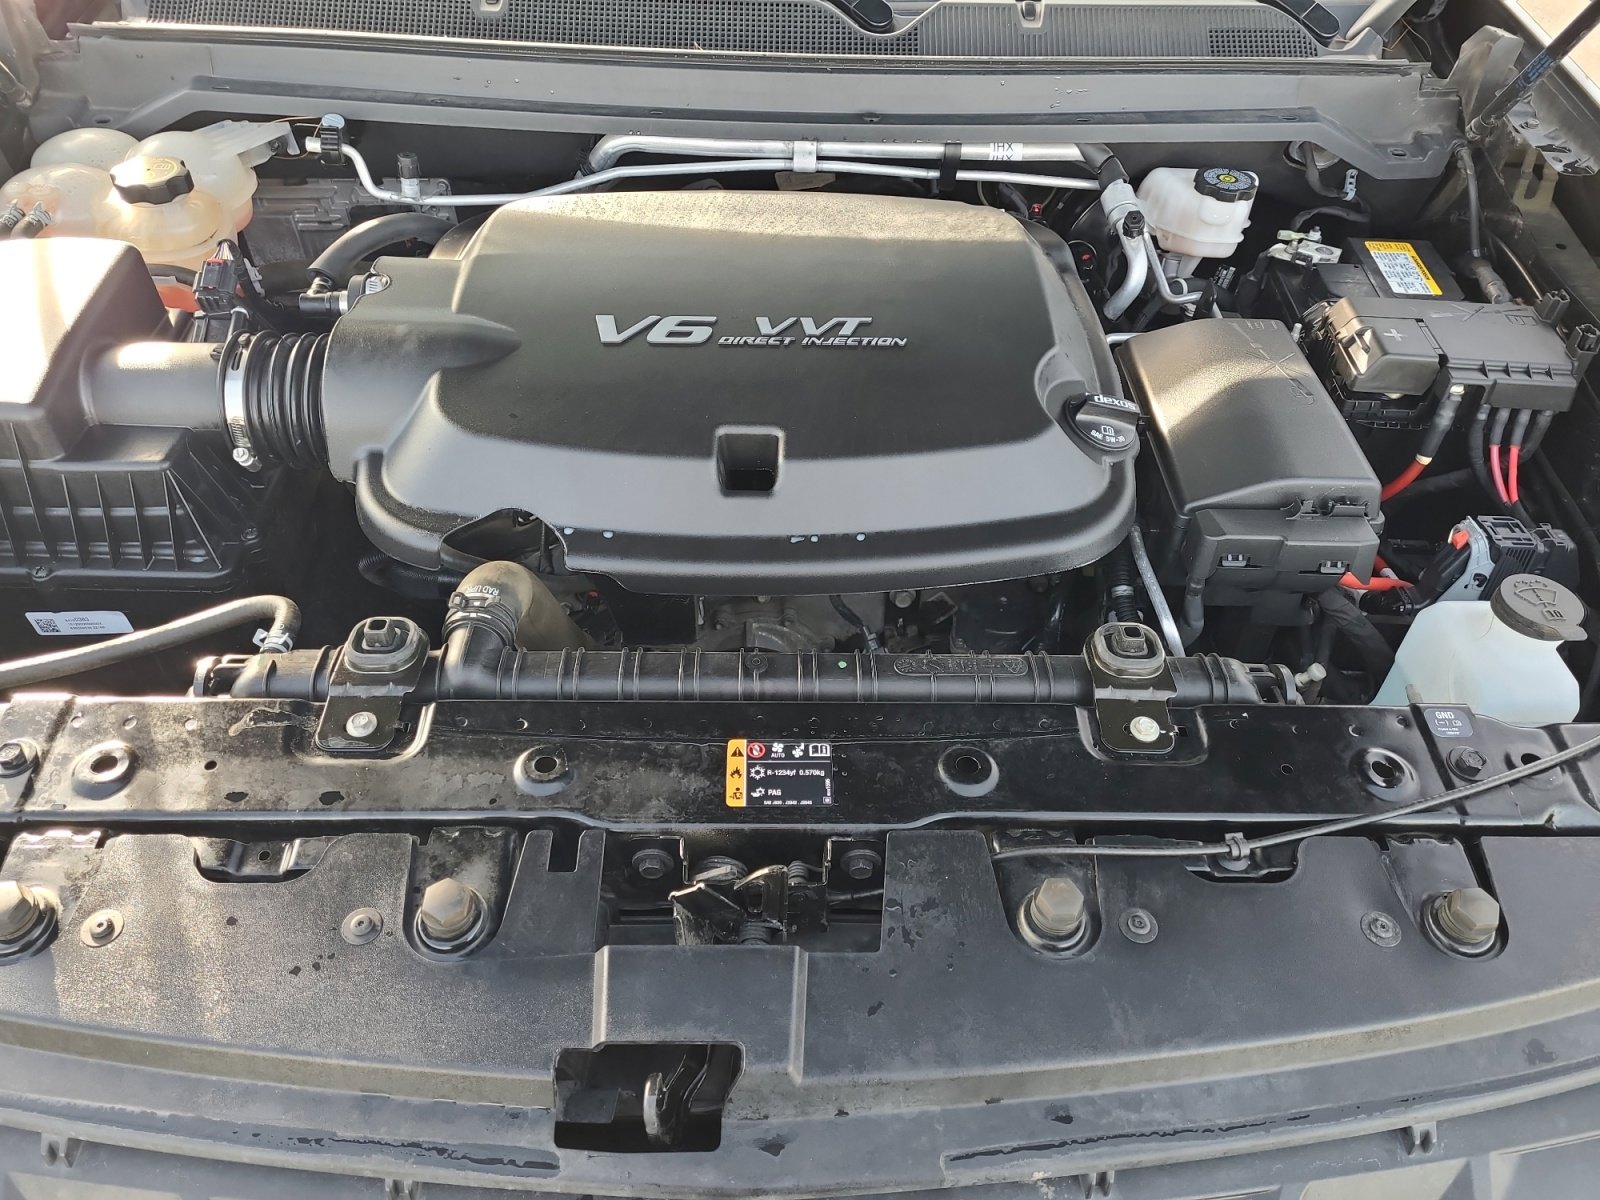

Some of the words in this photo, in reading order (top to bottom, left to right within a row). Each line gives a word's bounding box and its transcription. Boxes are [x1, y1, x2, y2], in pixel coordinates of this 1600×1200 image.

[595, 314, 718, 345] V6
[755, 316, 873, 337] VVT
[717, 336, 796, 346] DIRECT
[801, 336, 907, 347] INJECTION
[1094, 394, 1137, 410] dexos
[482, 585, 500, 596] RAD
[1435, 711, 1455, 719] GND
[766, 769, 797, 777] R-1234yf
[799, 769, 825, 777] 0.570kg
